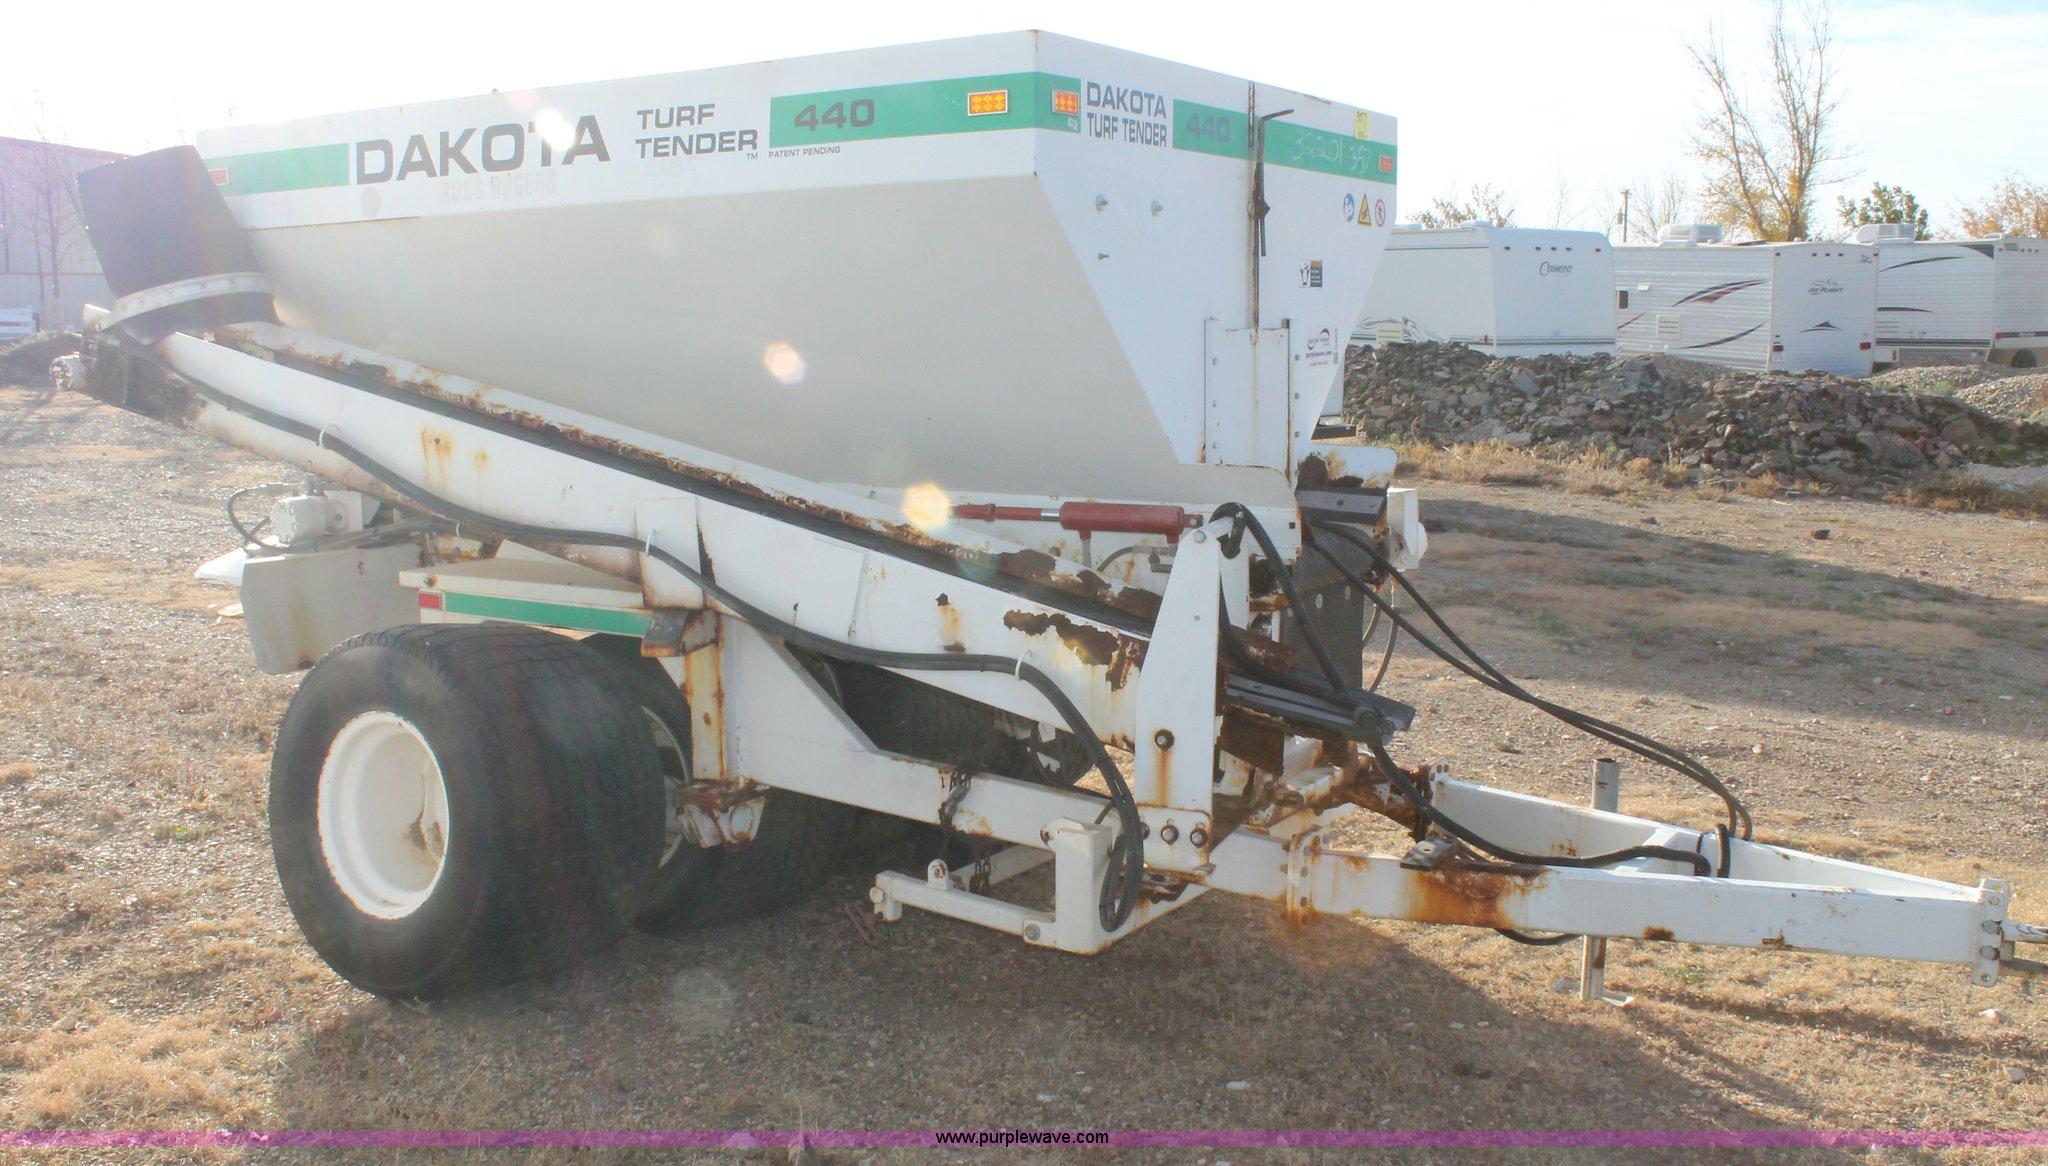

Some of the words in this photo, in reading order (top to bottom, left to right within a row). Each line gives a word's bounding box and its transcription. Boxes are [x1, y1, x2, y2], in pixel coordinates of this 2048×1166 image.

[1087, 81, 1167, 119] DAKOTA
[637, 103, 716, 130] TURF
[794, 98, 875, 132] 440
[1087, 112, 1118, 138] TURF
[1121, 118, 1167, 147] TENDER
[1186, 113, 1230, 142] 440
[635, 129, 758, 158] TENDER
[768, 149, 800, 159] PATENT
[803, 146, 841, 156] PENDING
